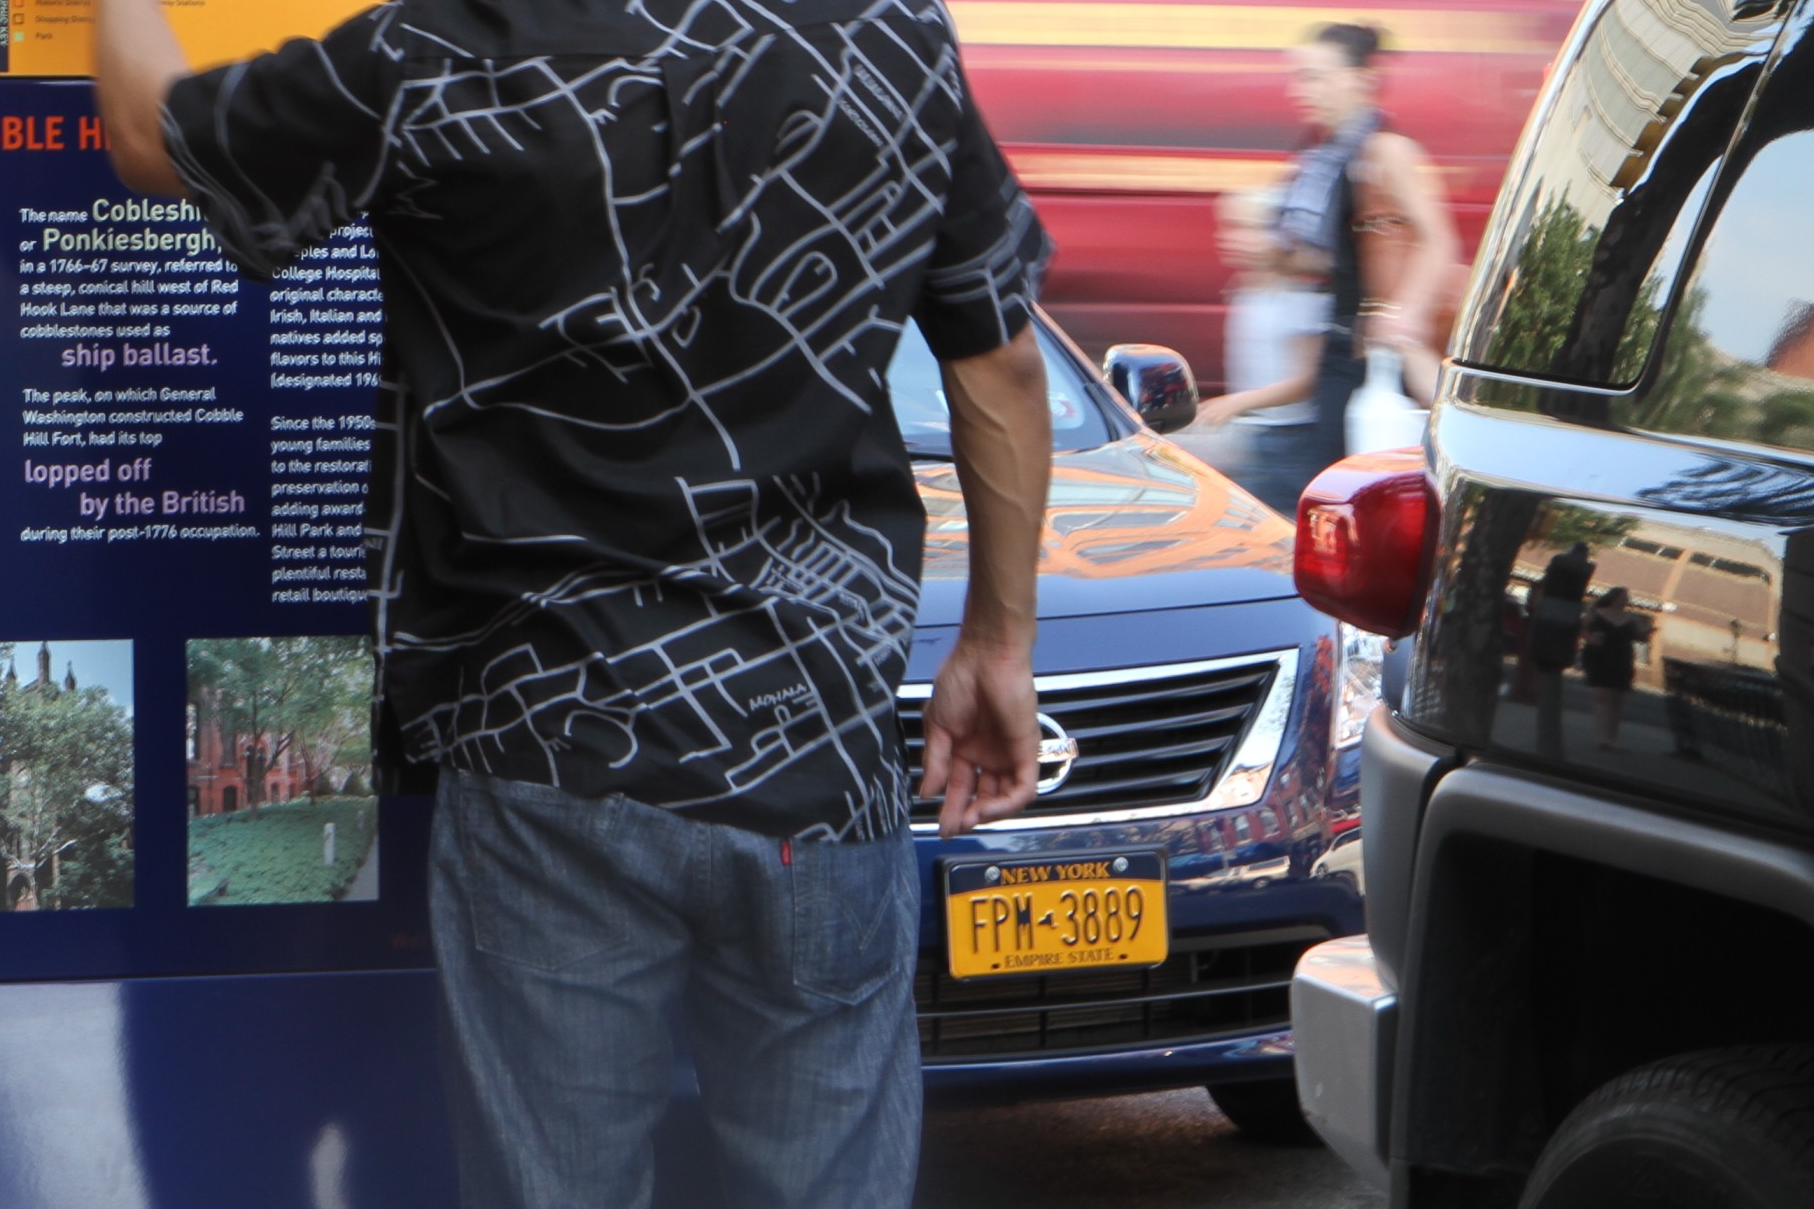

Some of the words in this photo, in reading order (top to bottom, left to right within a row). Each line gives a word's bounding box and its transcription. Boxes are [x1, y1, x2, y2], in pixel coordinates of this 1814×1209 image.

[19, 208, 46, 222] The
[47, 211, 88, 222] name
[19, 242, 36, 252] or
[43, 228, 222, 256] Ponkiesbergh,
[331, 245, 357, 258] and
[19, 260, 33, 273] in
[36, 263, 46, 273] a
[110, 261, 162, 275] survey,
[164, 258, 223, 273] referred
[226, 262, 238, 273] to
[272, 266, 322, 283] College
[325, 265, 380, 283] Hospital
[19, 284, 29, 295] a
[32, 282, 75, 297] steep,
[78, 280, 128, 294] conical
[131, 280, 155, 293] hill
[157, 281, 191, 293] west
[193, 279, 208, 292] of
[211, 280, 239, 292] Red
[269, 287, 324, 305] original
[20, 302, 57, 316] Hook
[60, 303, 95, 316] Lane
[98, 302, 127, 315] that
[129, 304, 158, 315] was
[160, 305, 170, 315] a
[172, 304, 220, 315] source
[222, 301, 238, 315] of
[270, 309, 308, 325] Irish,
[310, 308, 354, 323] Italian
[356, 309, 382, 323] and
[20, 324, 114, 338] cobblestones
[116, 323, 150, 337] used
[153, 325, 170, 337] as
[270, 331, 320, 345] natives
[323, 330, 365, 344] added
[61, 343, 115, 372] ship
[122, 342, 218, 366] ballast.
[270, 352, 319, 366] flavors
[321, 353, 336, 365] to
[338, 352, 365, 365] this
[271, 372, 351, 390] (designated
[22, 389, 50, 403] The
[53, 388, 91, 405] peak,
[94, 391, 113, 402] on
[115, 388, 157, 402] which
[159, 387, 216, 402] General
[22, 410, 106, 427] Washington
[109, 409, 192, 423] constructed
[195, 408, 244, 423] Cobble
[270, 416, 309, 431] Since
[312, 416, 335, 430] the
[339, 415, 376, 430] 1950s
[23, 432, 49, 446] Hill
[52, 432, 86, 447] Fort,
[89, 431, 116, 445] had
[118, 431, 137, 444] its
[139, 432, 163, 448] top
[271, 440, 313, 455] young
[315, 437, 370, 452] families
[24, 458, 110, 488] lopped
[117, 457, 152, 482] off
[271, 460, 286, 473] to
[288, 459, 312, 473] the
[271, 480, 359, 498] preservation
[80, 492, 109, 521] by
[114, 492, 155, 515] the
[162, 490, 245, 515] British
[271, 502, 318, 519] adding
[21, 527, 68, 544] during
[70, 526, 105, 540] their
[107, 525, 177, 542] post-1776
[180, 523, 261, 541] occupation.
[271, 523, 297, 538] Hill
[299, 523, 333, 538] Park
[336, 523, 362, 537] and
[271, 545, 316, 559] Street
[317, 547, 328, 559] a
[272, 566, 330, 584] plentiful
[272, 588, 310, 603] retail
[749, 683, 807, 711] MOHALA
[1001, 867, 1050, 885] NEW
[1055, 861, 1111, 880] YORK
[1060, 886, 1145, 946] 3889
[1005, 951, 1063, 969] EMPIRE
[1067, 948, 1114, 965] STATE
